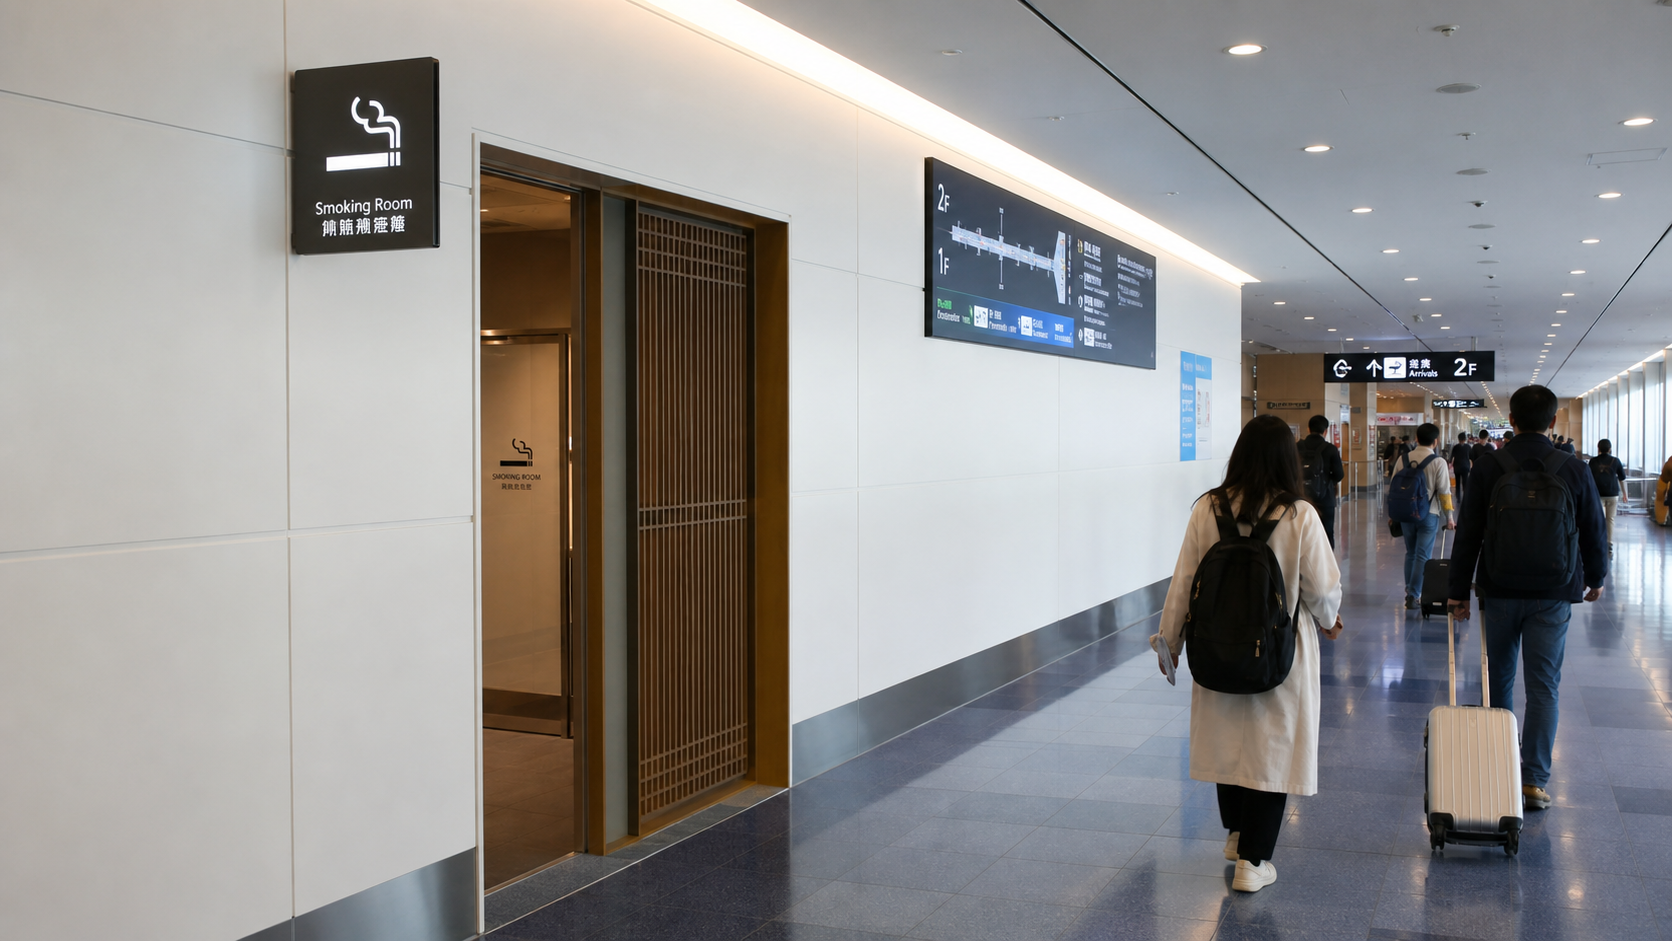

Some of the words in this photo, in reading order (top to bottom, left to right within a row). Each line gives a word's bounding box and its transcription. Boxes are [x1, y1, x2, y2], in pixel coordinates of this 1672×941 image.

[315, 199, 371, 215] Smoking
[375, 197, 412, 212] Room
[937, 183, 950, 213] 2F
[938, 247, 949, 275] 1F
[1409, 369, 1438, 377] Arrivals
[1453, 357, 1477, 376] 2F
